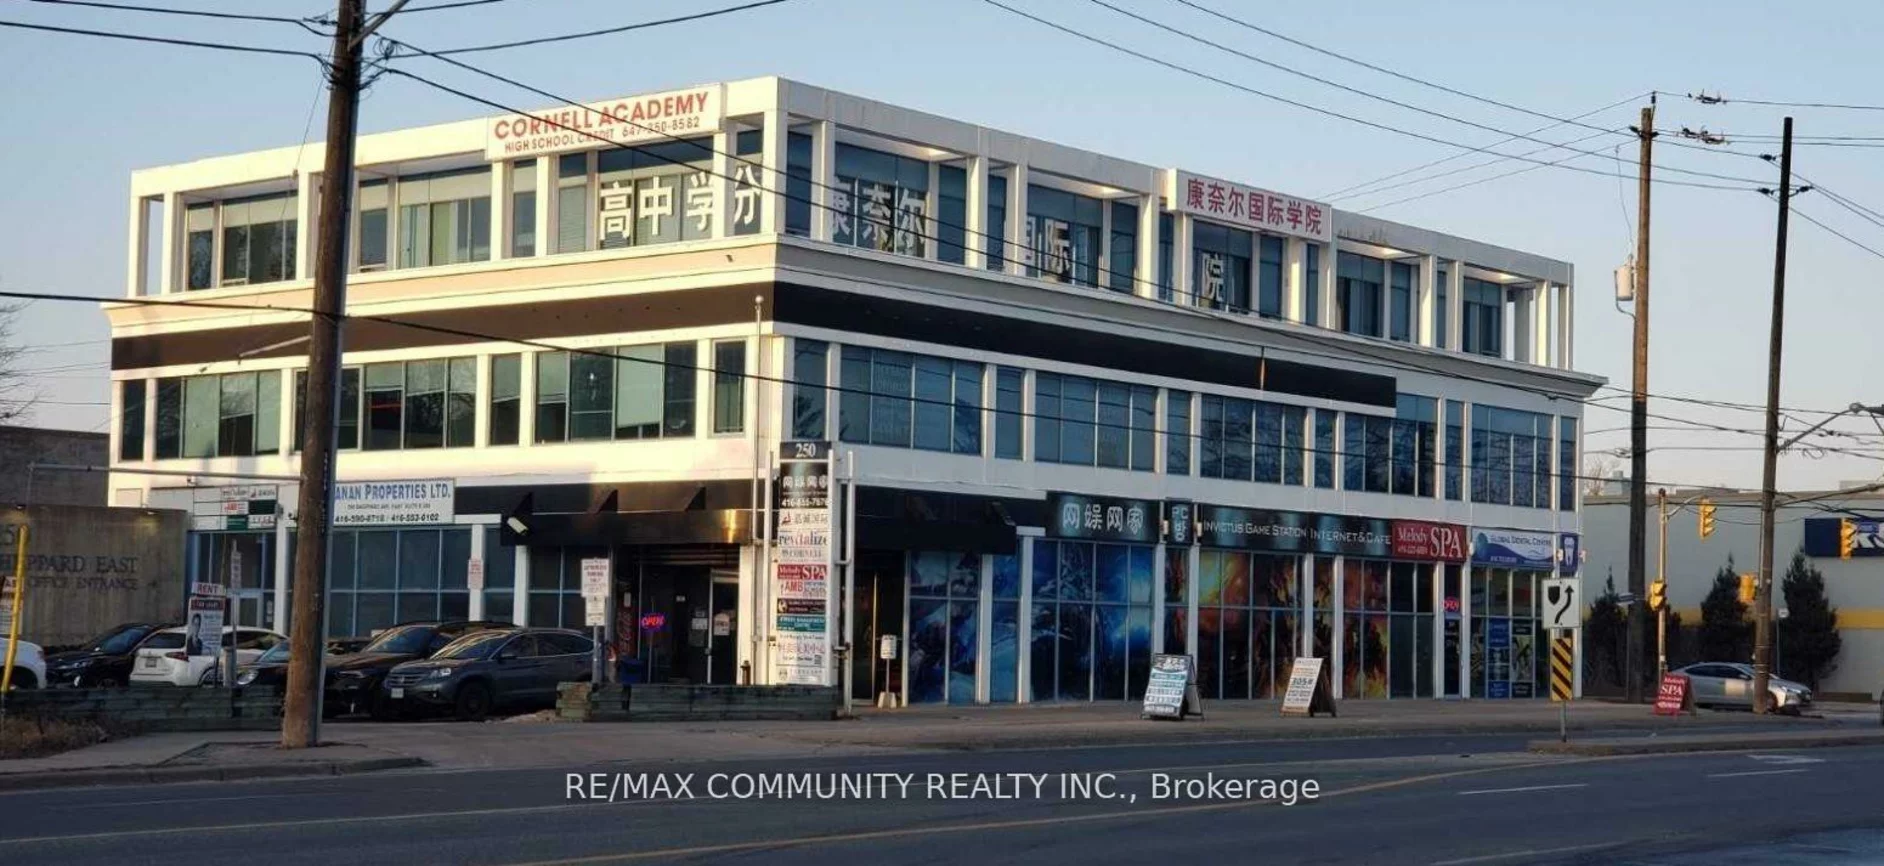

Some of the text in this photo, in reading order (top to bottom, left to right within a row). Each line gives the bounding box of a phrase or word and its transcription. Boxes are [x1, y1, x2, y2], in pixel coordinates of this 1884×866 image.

[494, 91, 709, 140] CORNELL ACADEMY
[504, 141, 530, 154] HIGH
[532, 136, 575, 149] SCHOOL
[1187, 178, 1322, 235] 康奈尔国际学院
[795, 443, 816, 458] 250
[364, 482, 427, 500] PROPERTIES
[431, 482, 452, 499] LTD.
[1245, 522, 1271, 536] GAME
[1272, 525, 1307, 538] STATION
[1397, 526, 1464, 558] Melody SPA
[97, 555, 138, 574] EAST
[803, 565, 827, 580] SPA
[641, 614, 665, 629] OPEN
[1660, 685, 1683, 696] SPA
